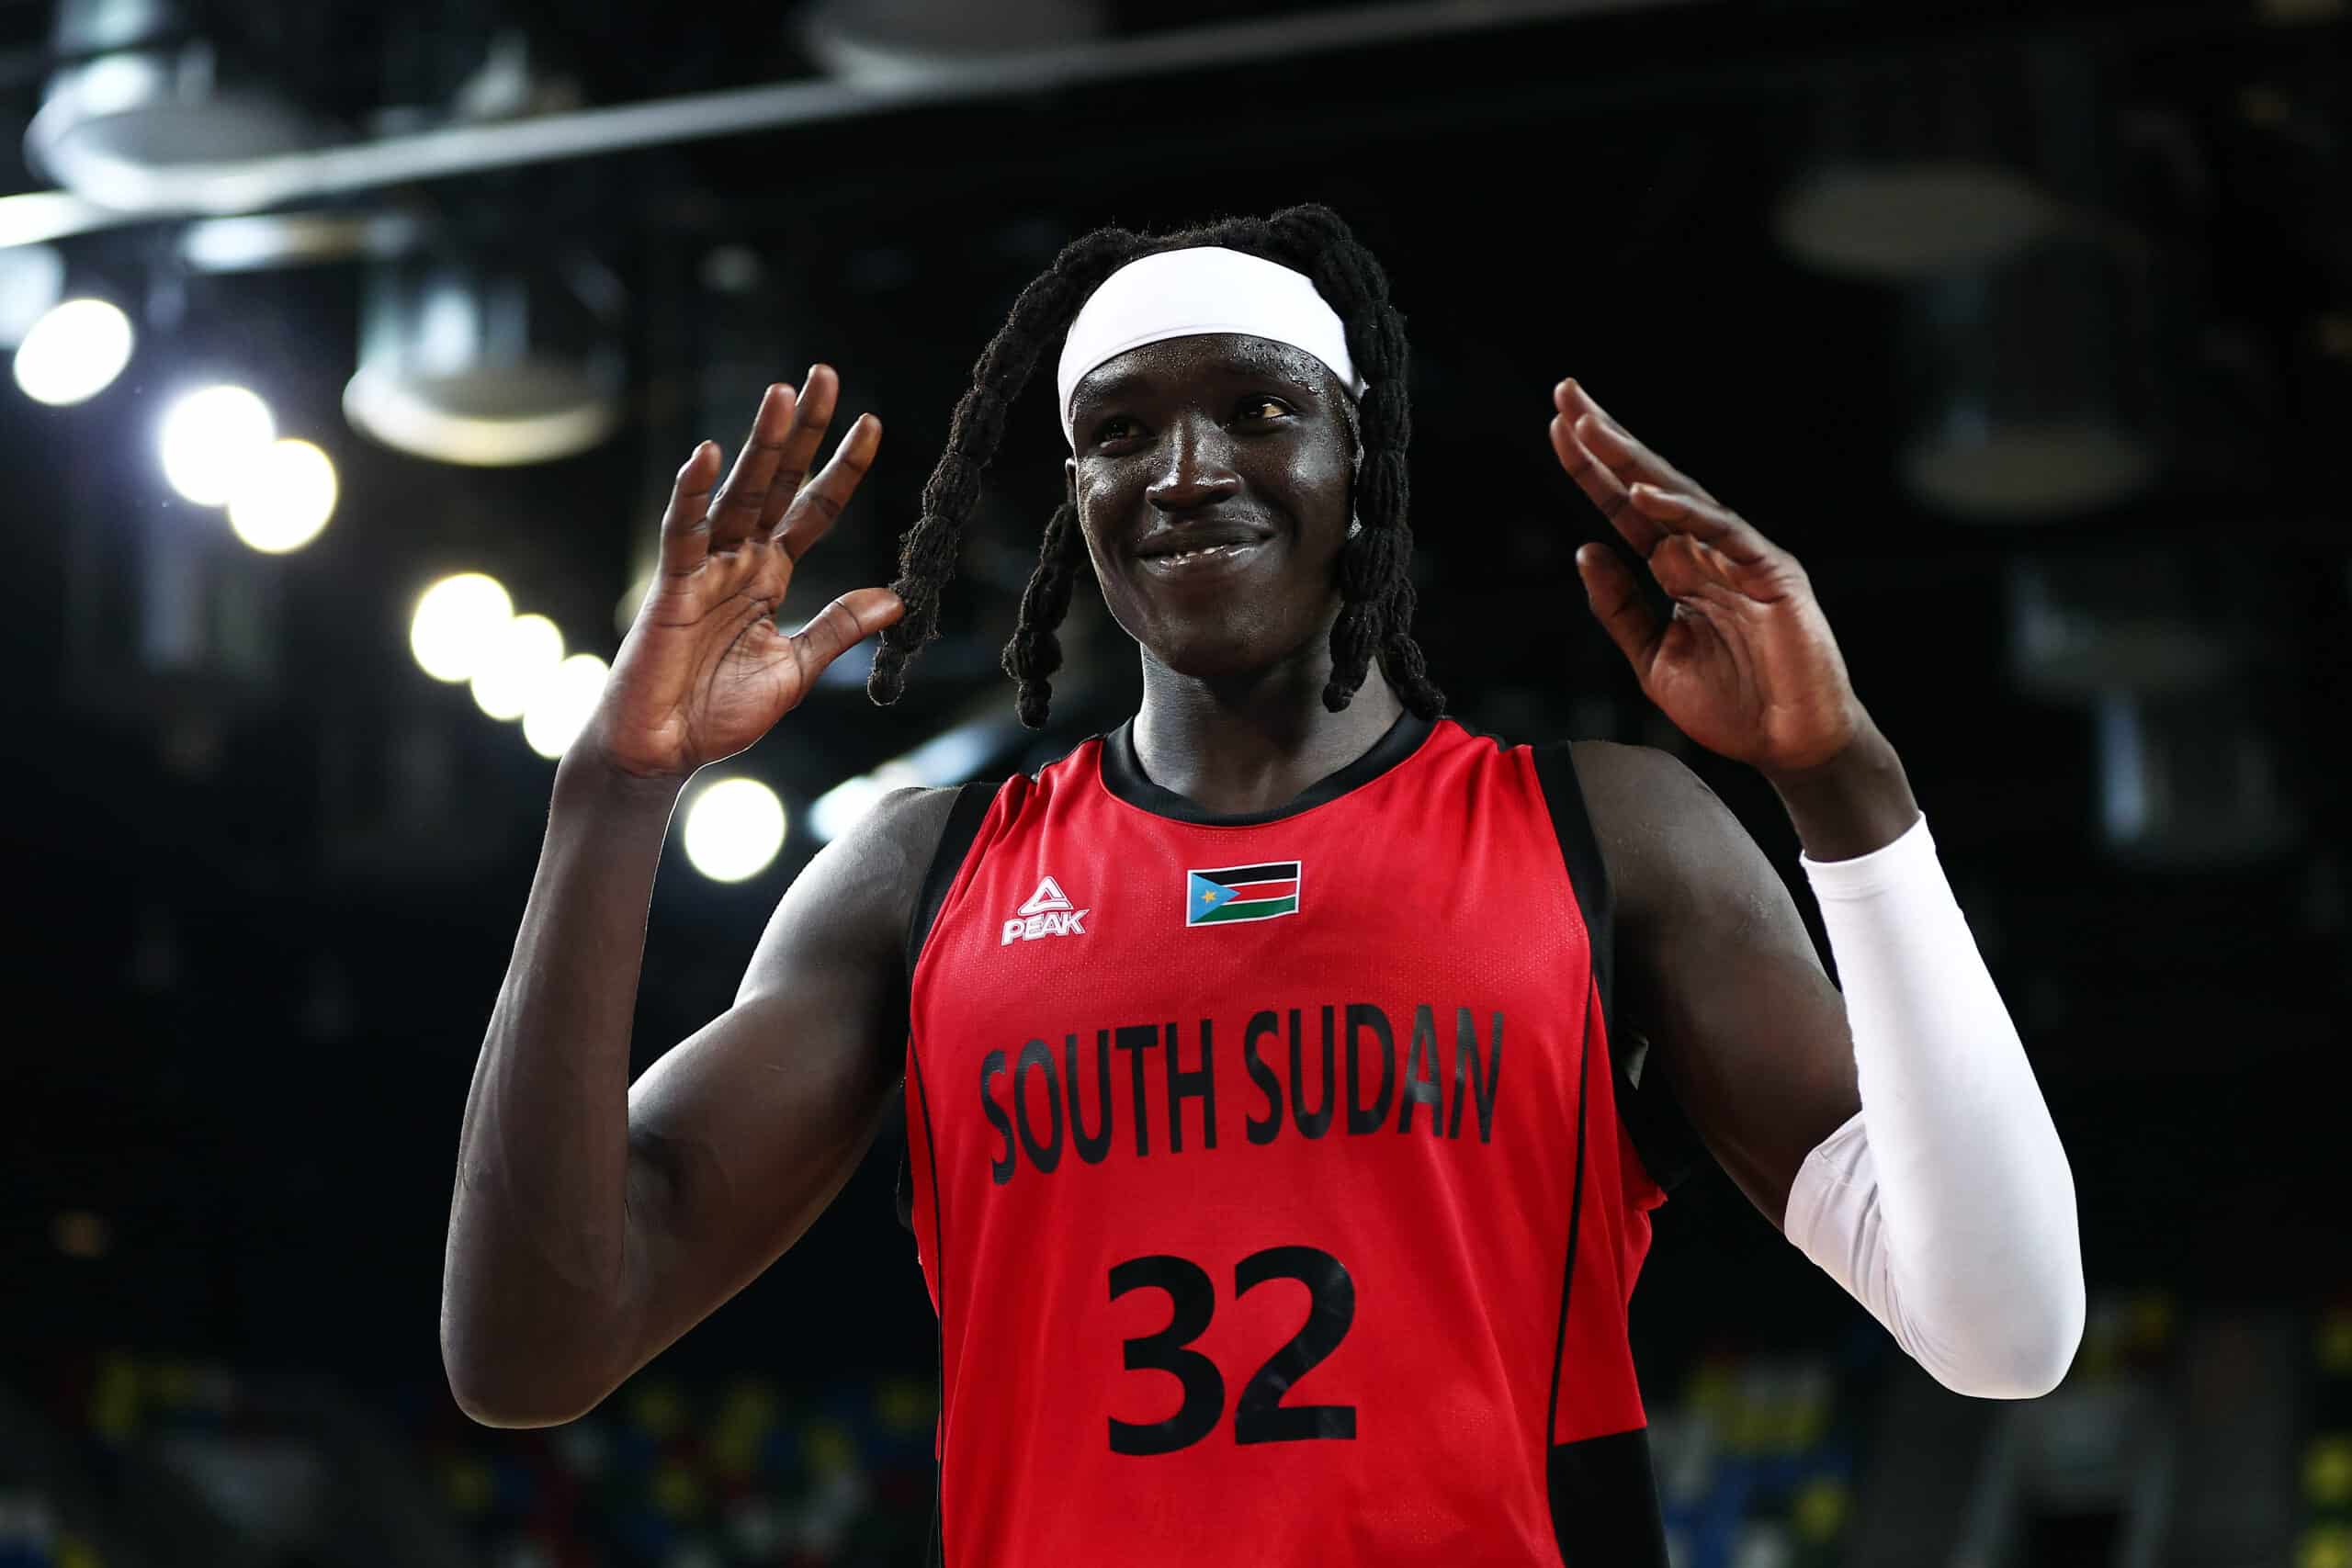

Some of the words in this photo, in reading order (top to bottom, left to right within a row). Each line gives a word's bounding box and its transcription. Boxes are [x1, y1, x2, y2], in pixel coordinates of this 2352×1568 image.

[1001, 908, 1091, 946] PEAK
[979, 1019, 1218, 1186] SOUTH
[1243, 1003, 1504, 1146] SUDAN
[1107, 1245, 1357, 1457] 32
